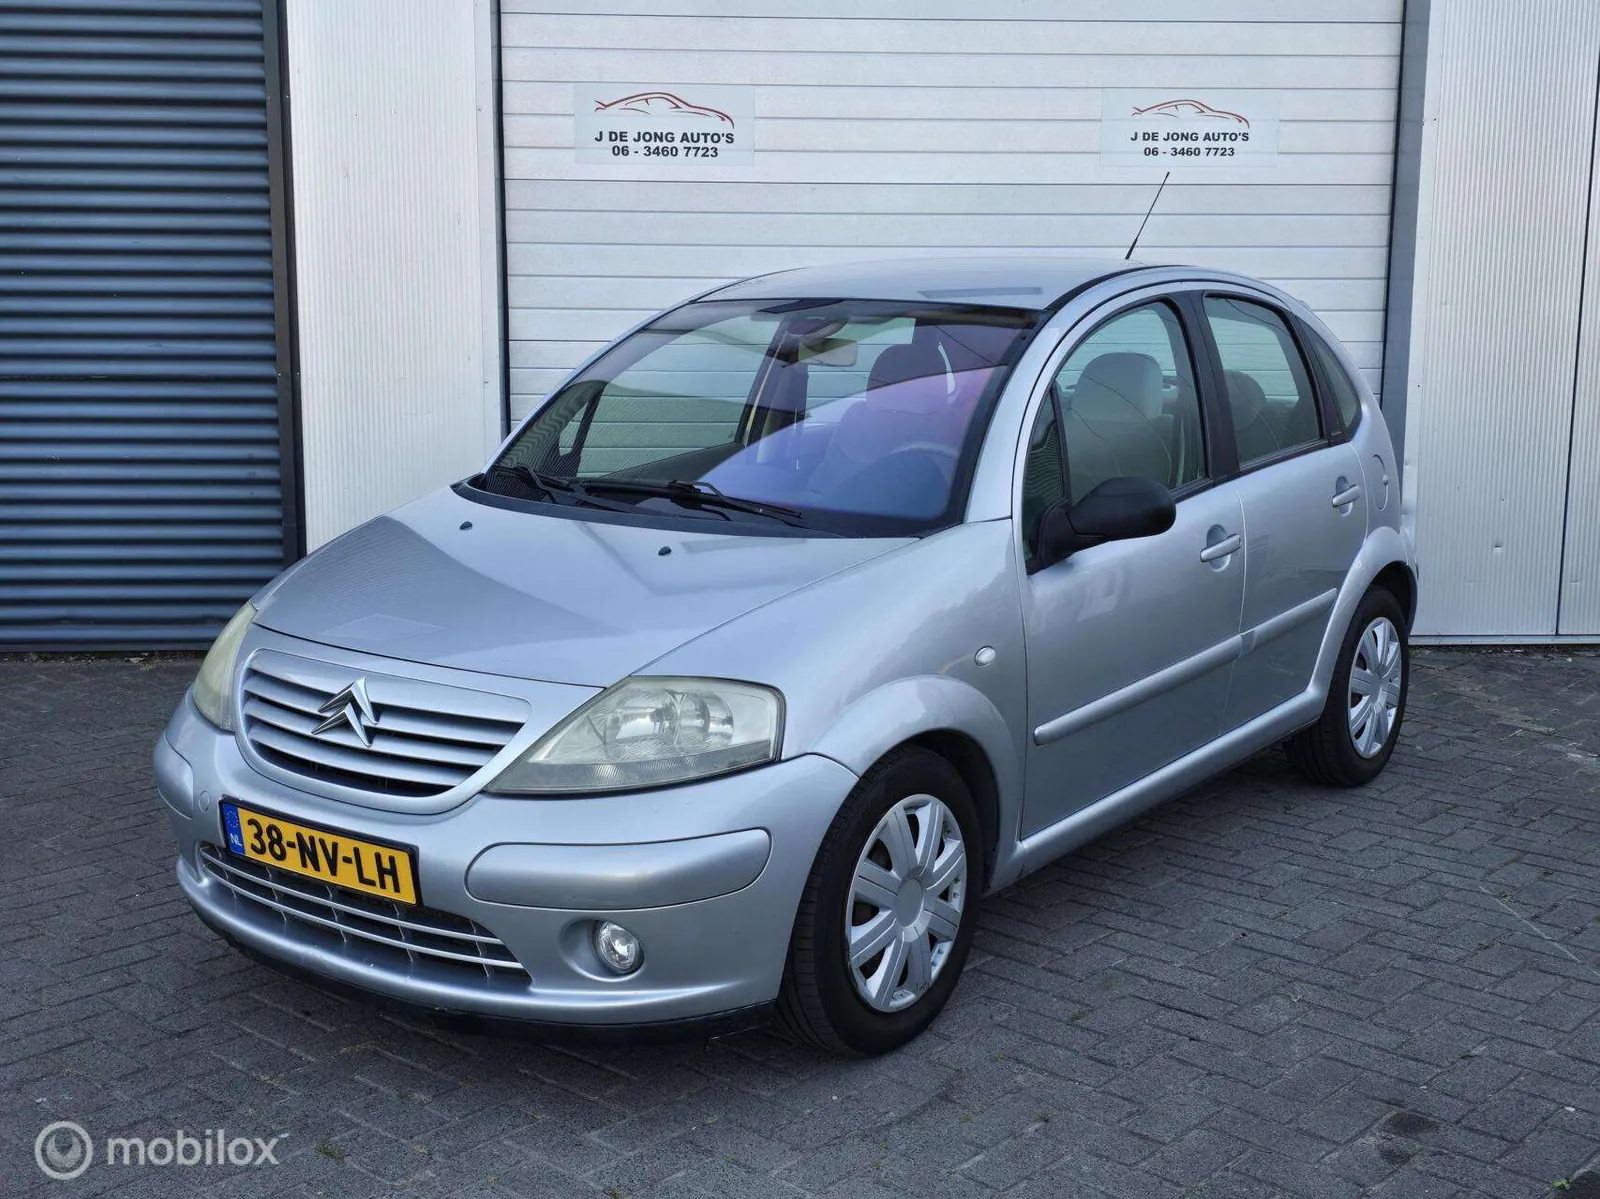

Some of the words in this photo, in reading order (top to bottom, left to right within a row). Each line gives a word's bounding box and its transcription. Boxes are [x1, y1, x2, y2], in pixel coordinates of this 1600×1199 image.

[595, 131, 603, 142] J
[609, 131, 628, 142] DE
[633, 131, 675, 143] JONG
[680, 132, 735, 144] AUTO'S
[1130, 132, 1138, 142] J
[1142, 132, 1159, 142] DE
[1163, 132, 1199, 142] JONG
[1202, 132, 1250, 142] AUTO'S
[612, 145, 630, 157] 06
[643, 145, 679, 157] 3460
[683, 146, 719, 158] 7723
[1143, 147, 1159, 157] 06
[1170, 147, 1201, 157] 3460
[1205, 147, 1235, 157] 7723
[230, 832, 242, 847] NL
[247, 818, 401, 893] 38-NV-LH
